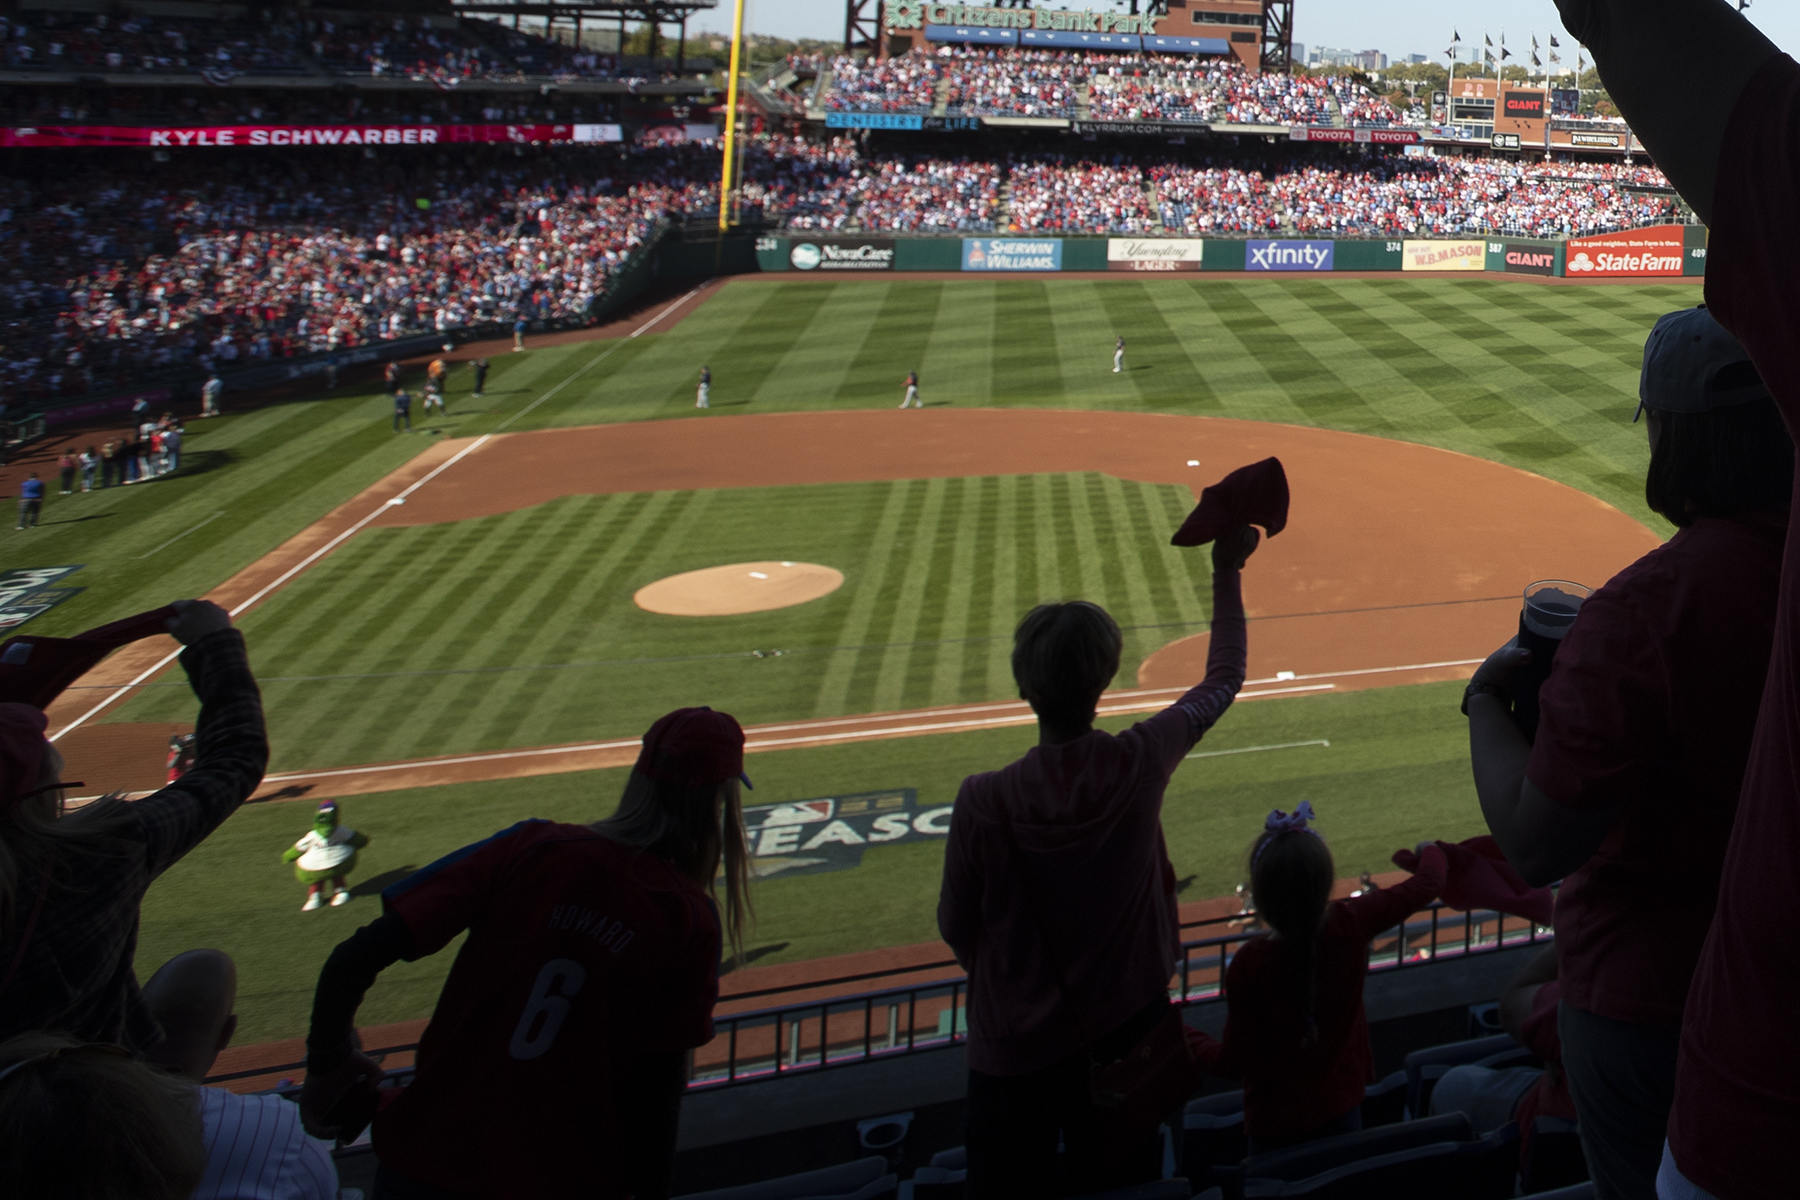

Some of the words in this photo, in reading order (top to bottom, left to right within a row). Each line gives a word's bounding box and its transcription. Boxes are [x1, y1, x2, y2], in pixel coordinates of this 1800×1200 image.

[926, 3, 1031, 29] Citizens
[1034, 9, 1099, 32] Bank
[1101, 11, 1157, 36] Park
[1507, 100, 1541, 110] GIANT
[829, 114, 920, 128] DENTISTRY
[945, 118, 979, 130] LIFE
[150, 129, 235, 146] KYLE
[249, 129, 438, 145] SCHWARBER
[1310, 131, 1351, 140] TOYOTA
[1373, 133, 1414, 141] TOYOTA
[821, 245, 894, 261] NovaCare
[988, 240, 1054, 255] SHERWIN
[1120, 241, 1190, 258] Yuengling
[1386, 242, 1401, 252] 374
[1691, 249, 1706, 258] 409
[1251, 242, 1329, 270] xfinity
[1506, 251, 1553, 267] GIANT
[1134, 260, 1176, 271] LAGER
[549, 904, 635, 954] HOWARD
[509, 958, 587, 1061] 6
